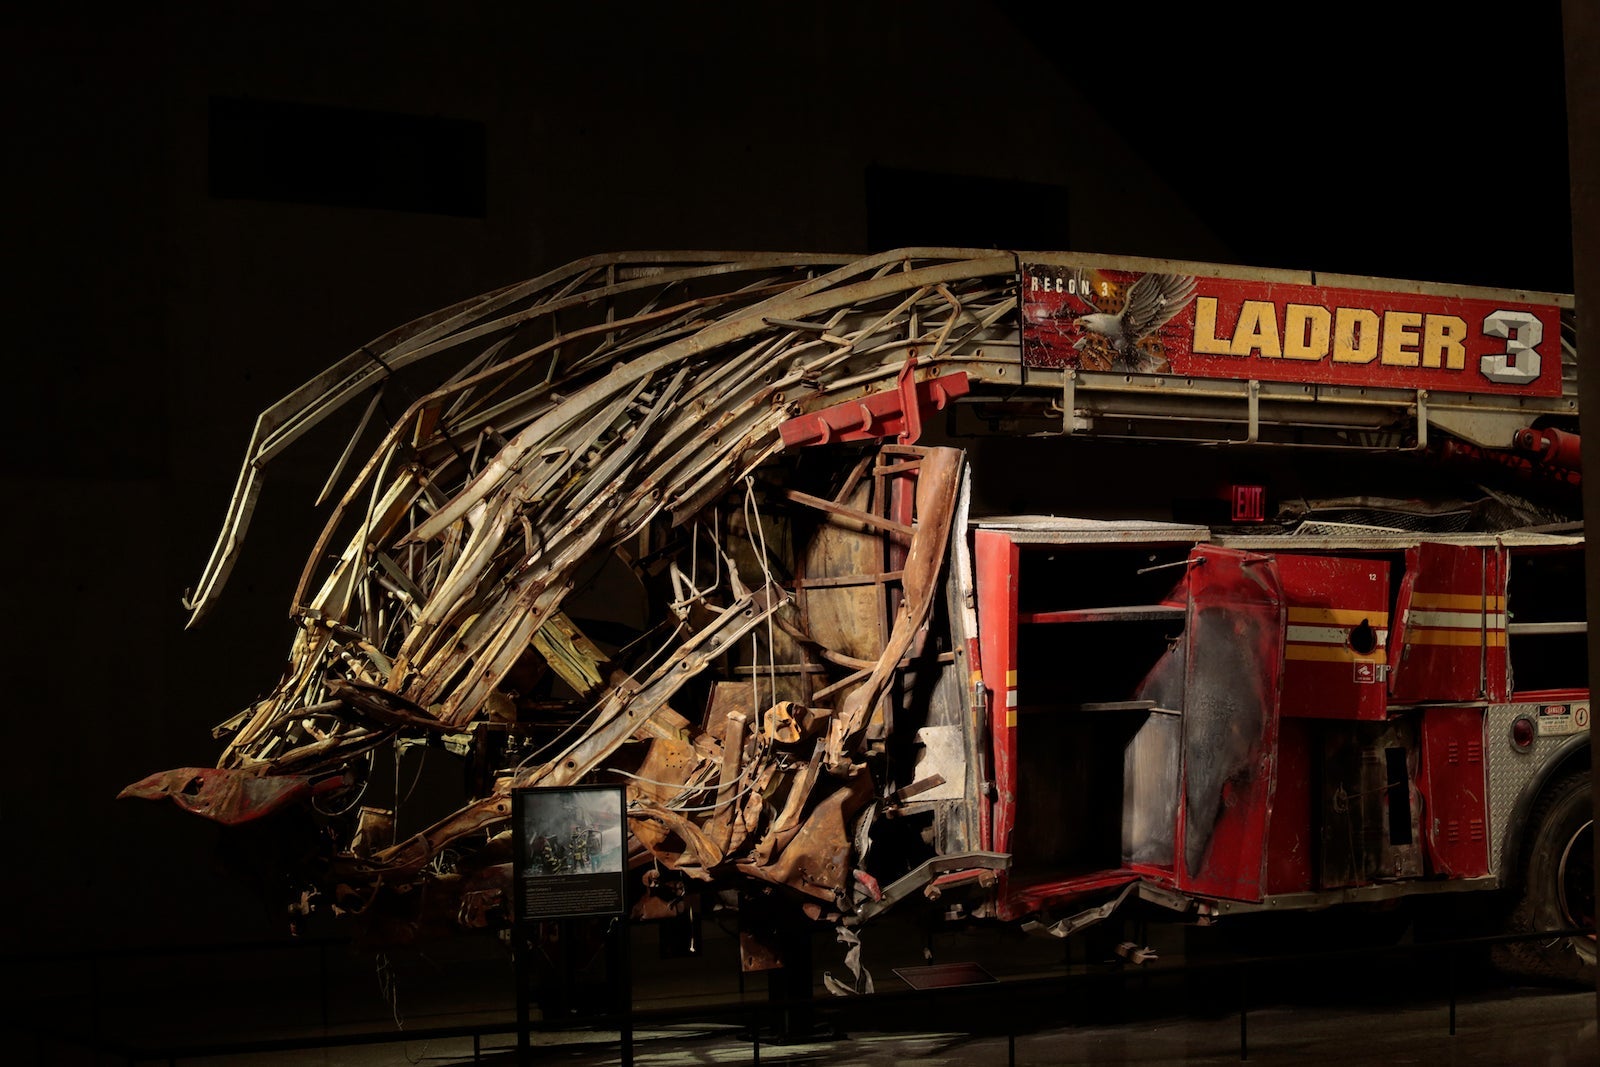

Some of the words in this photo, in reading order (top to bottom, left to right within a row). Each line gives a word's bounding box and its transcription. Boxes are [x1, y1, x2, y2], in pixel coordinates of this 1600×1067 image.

[1031, 276, 1090, 296] RECON
[1101, 282, 1109, 297] 3
[1191, 296, 1468, 371] LADDER
[1480, 308, 1544, 384] 3
[1237, 487, 1262, 518] EXIT
[1368, 573, 1377, 581] 12
